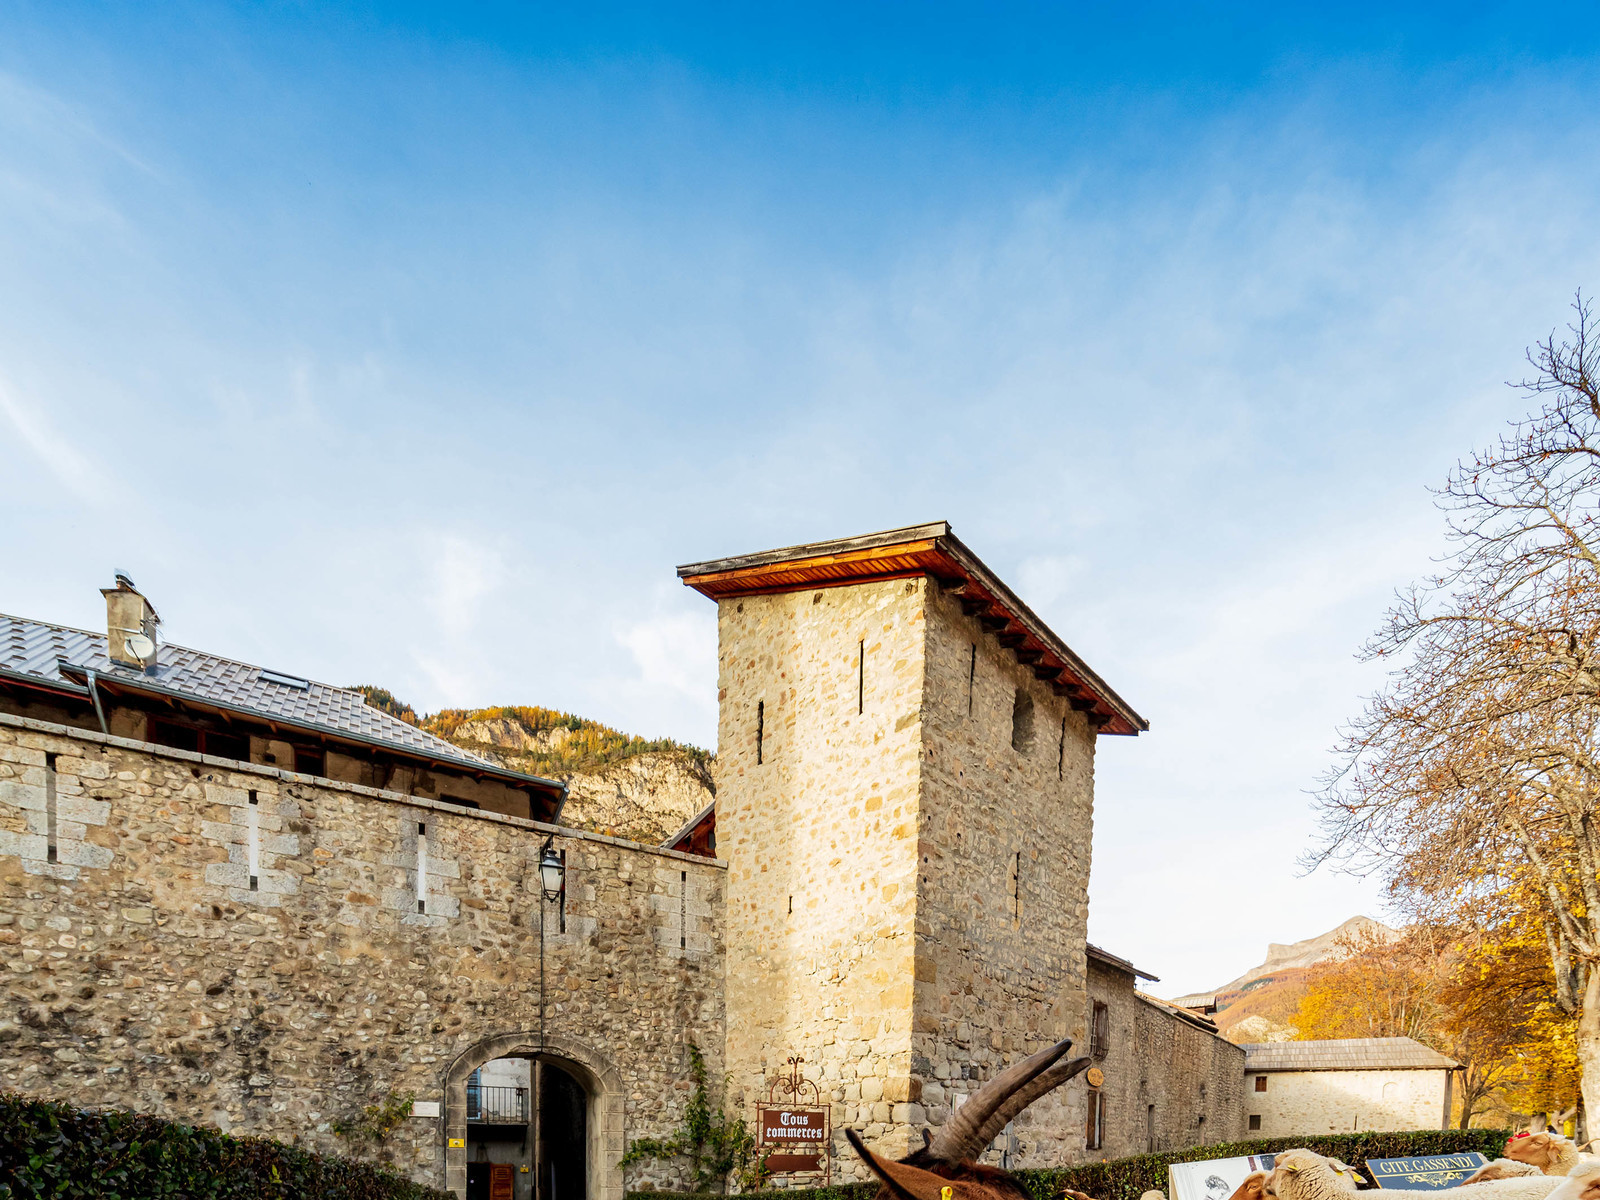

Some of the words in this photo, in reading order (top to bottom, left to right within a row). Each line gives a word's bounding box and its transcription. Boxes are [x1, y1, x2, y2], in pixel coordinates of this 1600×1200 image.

[780, 1112, 809, 1126] Tous
[766, 1126, 823, 1139] commerces
[1380, 1160, 1414, 1174] GITE
[1412, 1156, 1476, 1171] GASSENDI
